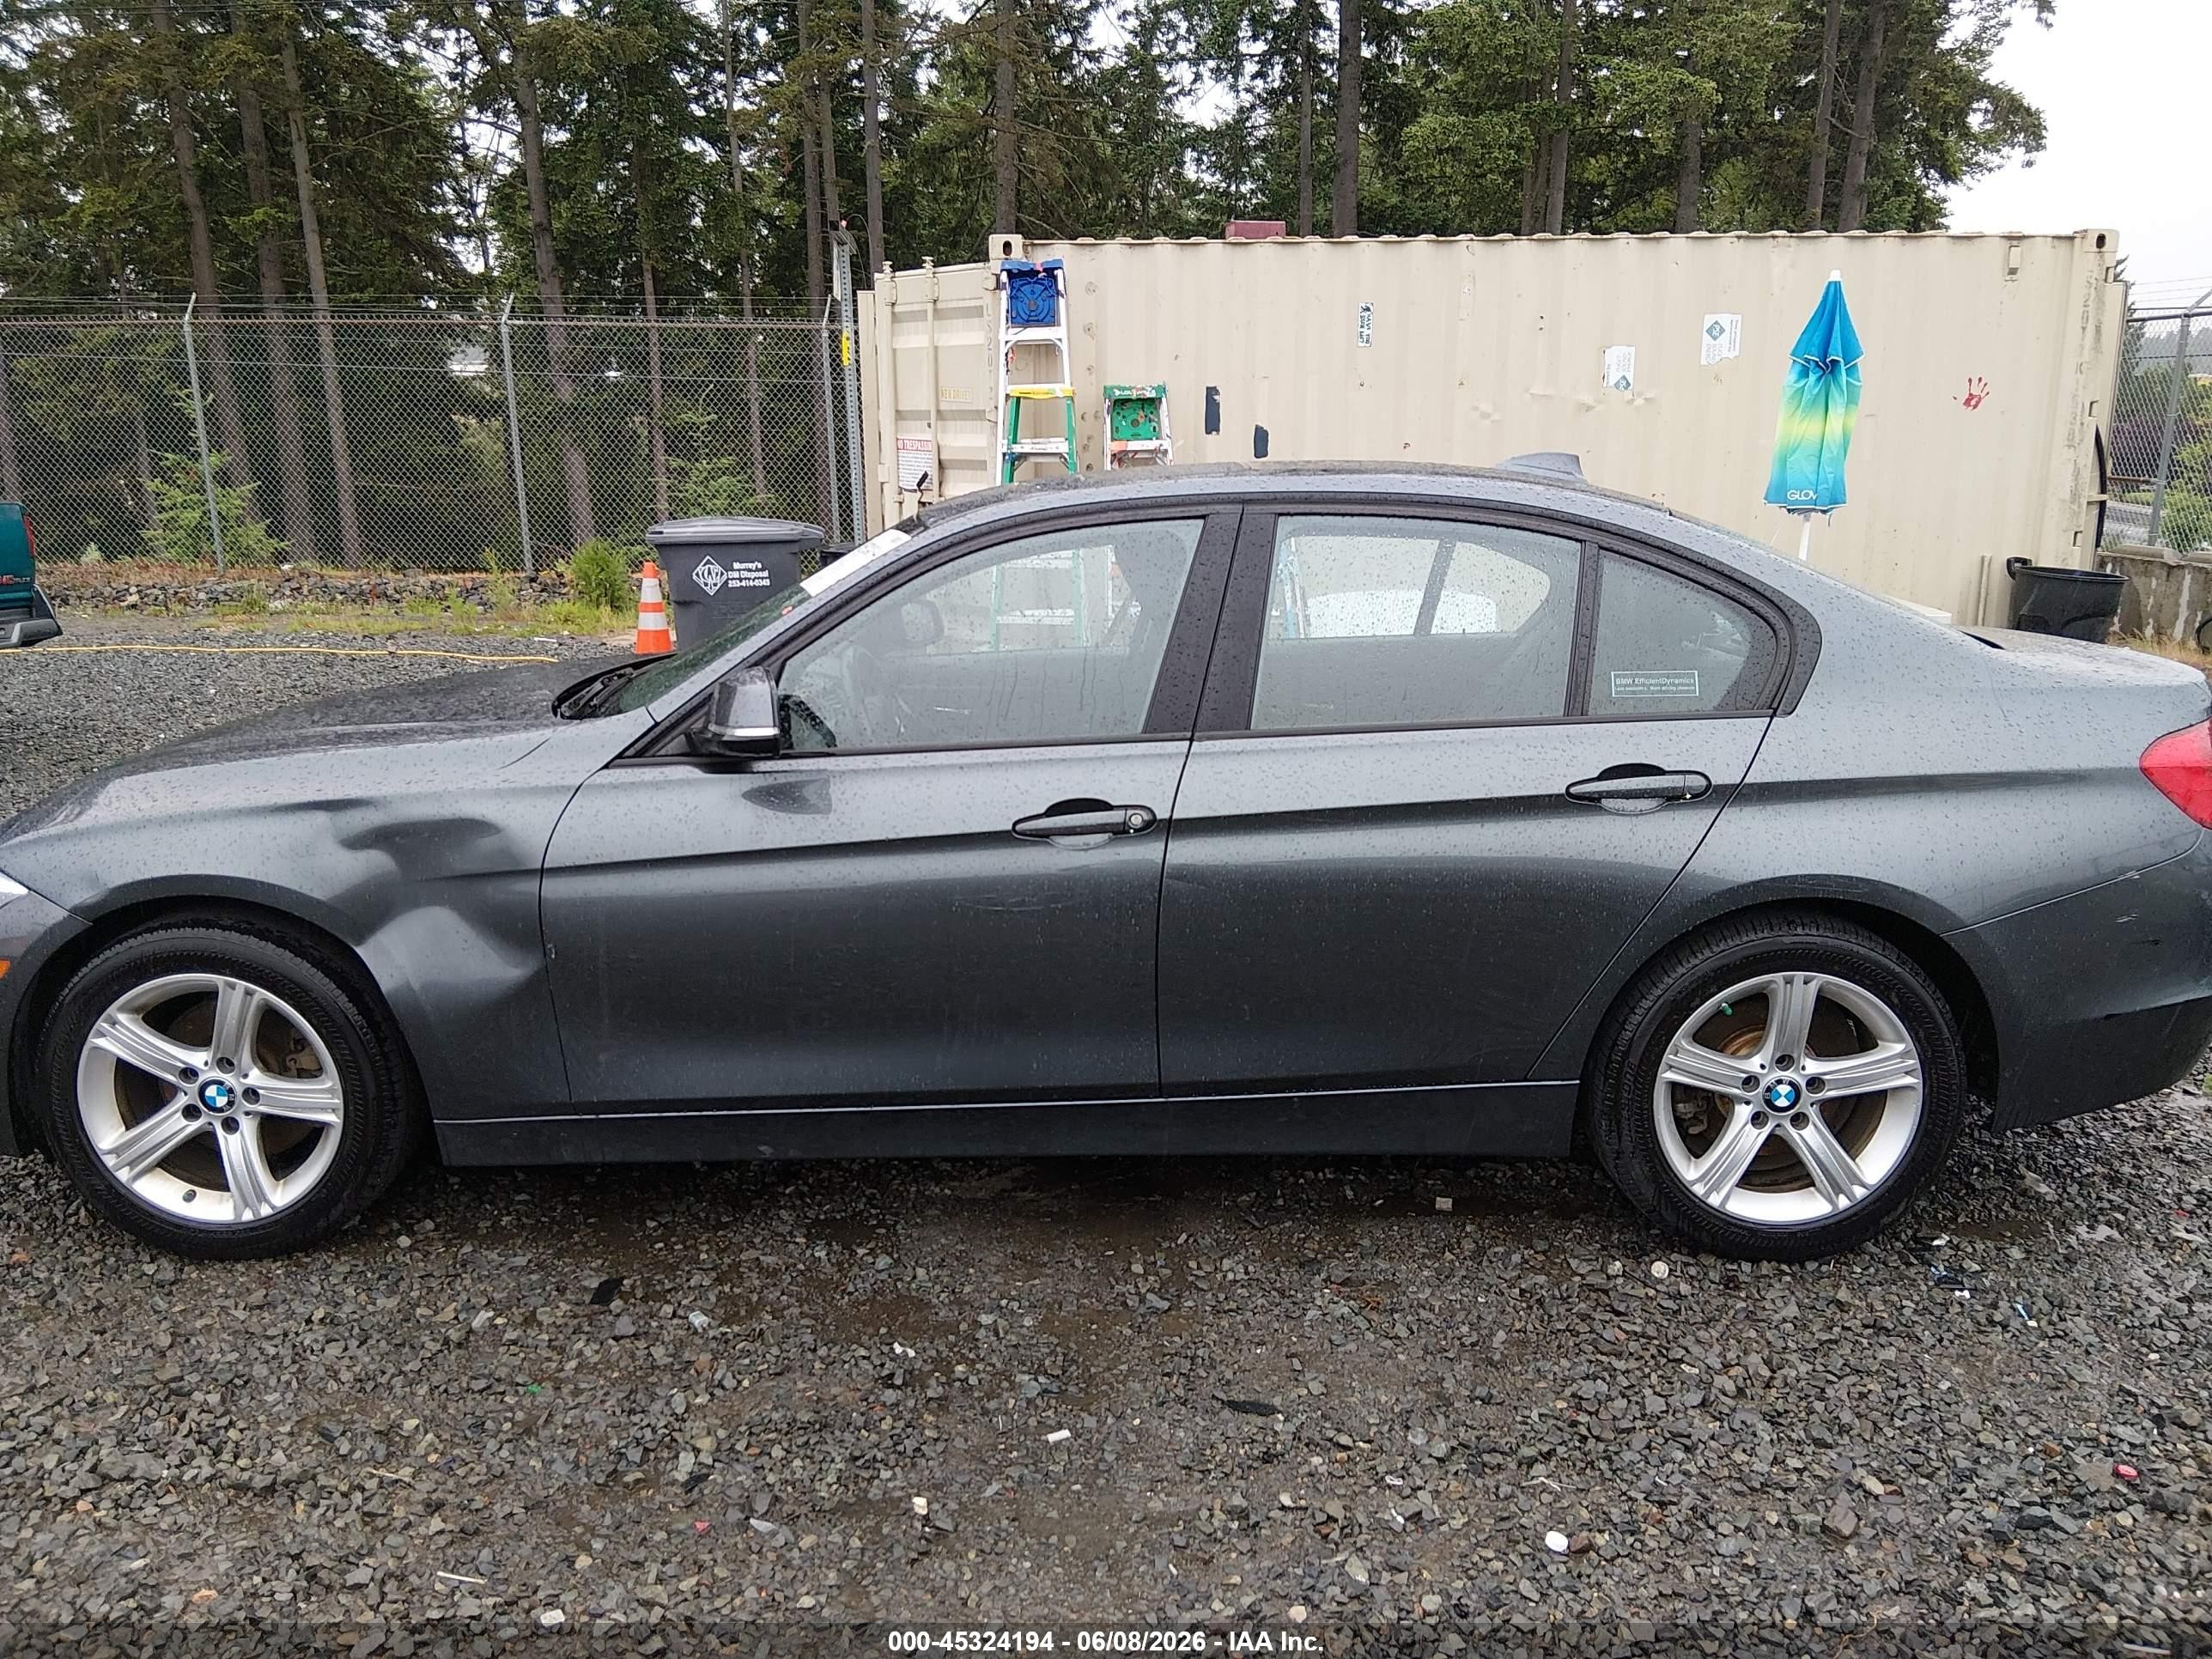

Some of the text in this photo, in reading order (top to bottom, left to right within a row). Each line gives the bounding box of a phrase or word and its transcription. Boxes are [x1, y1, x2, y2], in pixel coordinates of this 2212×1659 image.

[1711, 324, 1721, 337] PSE
[732, 561, 763, 570] Murrey's
[740, 569, 769, 580] Disposal
[1634, 677, 1694, 685] EfficientDynamics
